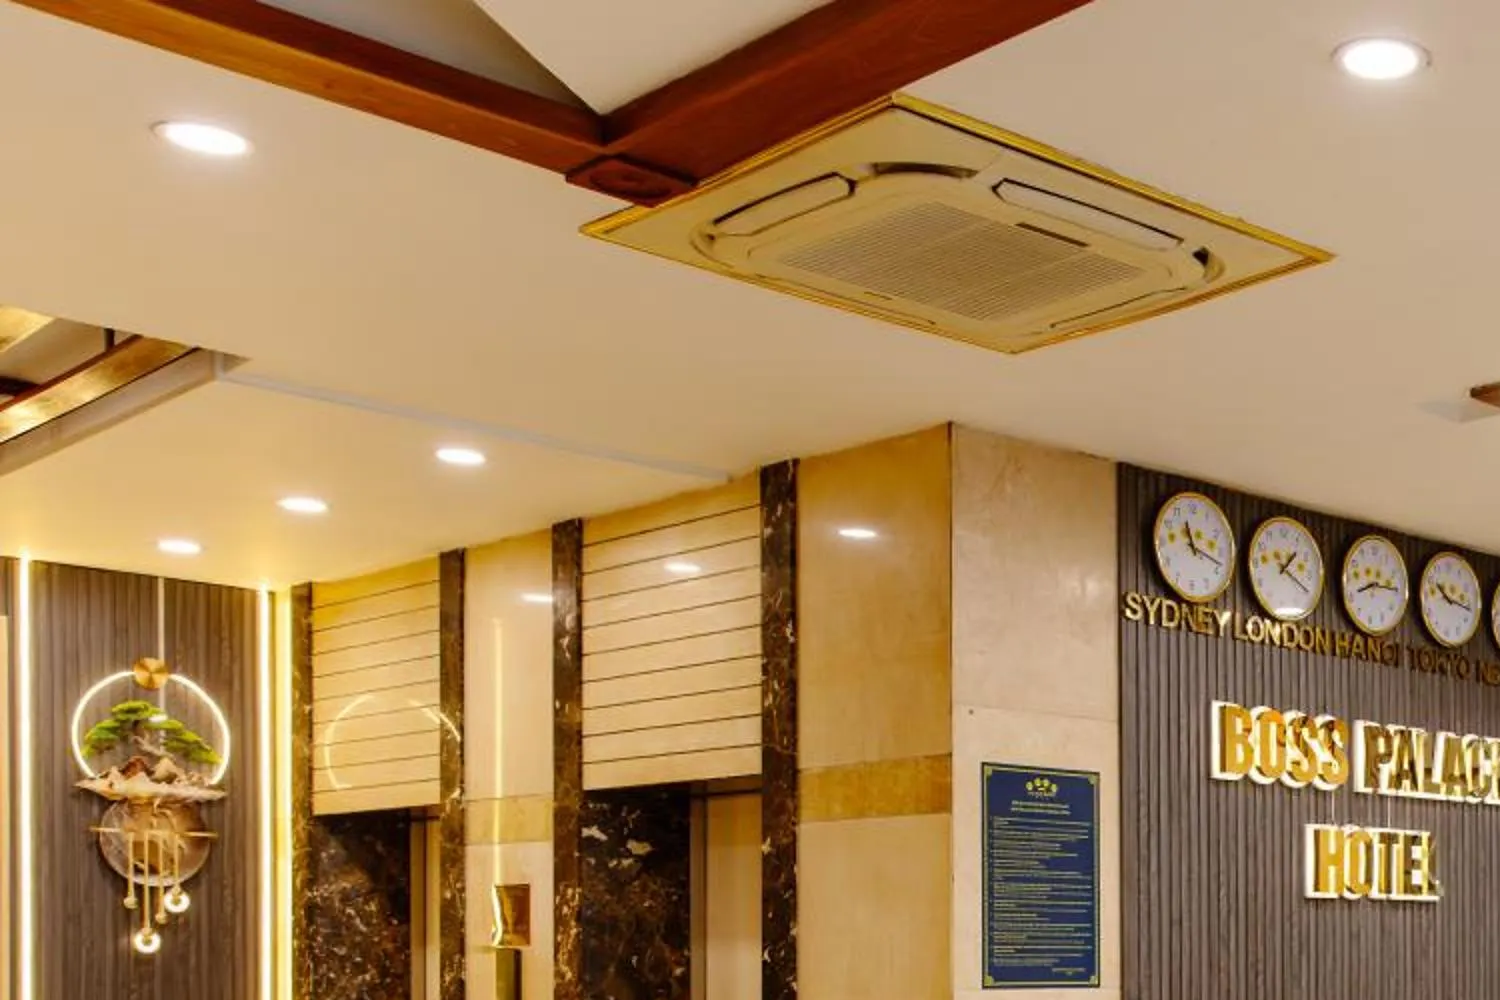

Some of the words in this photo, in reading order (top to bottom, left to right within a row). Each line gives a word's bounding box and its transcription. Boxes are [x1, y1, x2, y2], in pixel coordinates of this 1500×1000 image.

[1124, 592, 1231, 637] SYDNEY
[1231, 612, 1329, 656] LONDON
[1335, 632, 1400, 668] HANOI
[1407, 646, 1471, 680] TOKYO
[1210, 700, 1350, 791] BOSS
[1304, 823, 1442, 902] HOTEL
